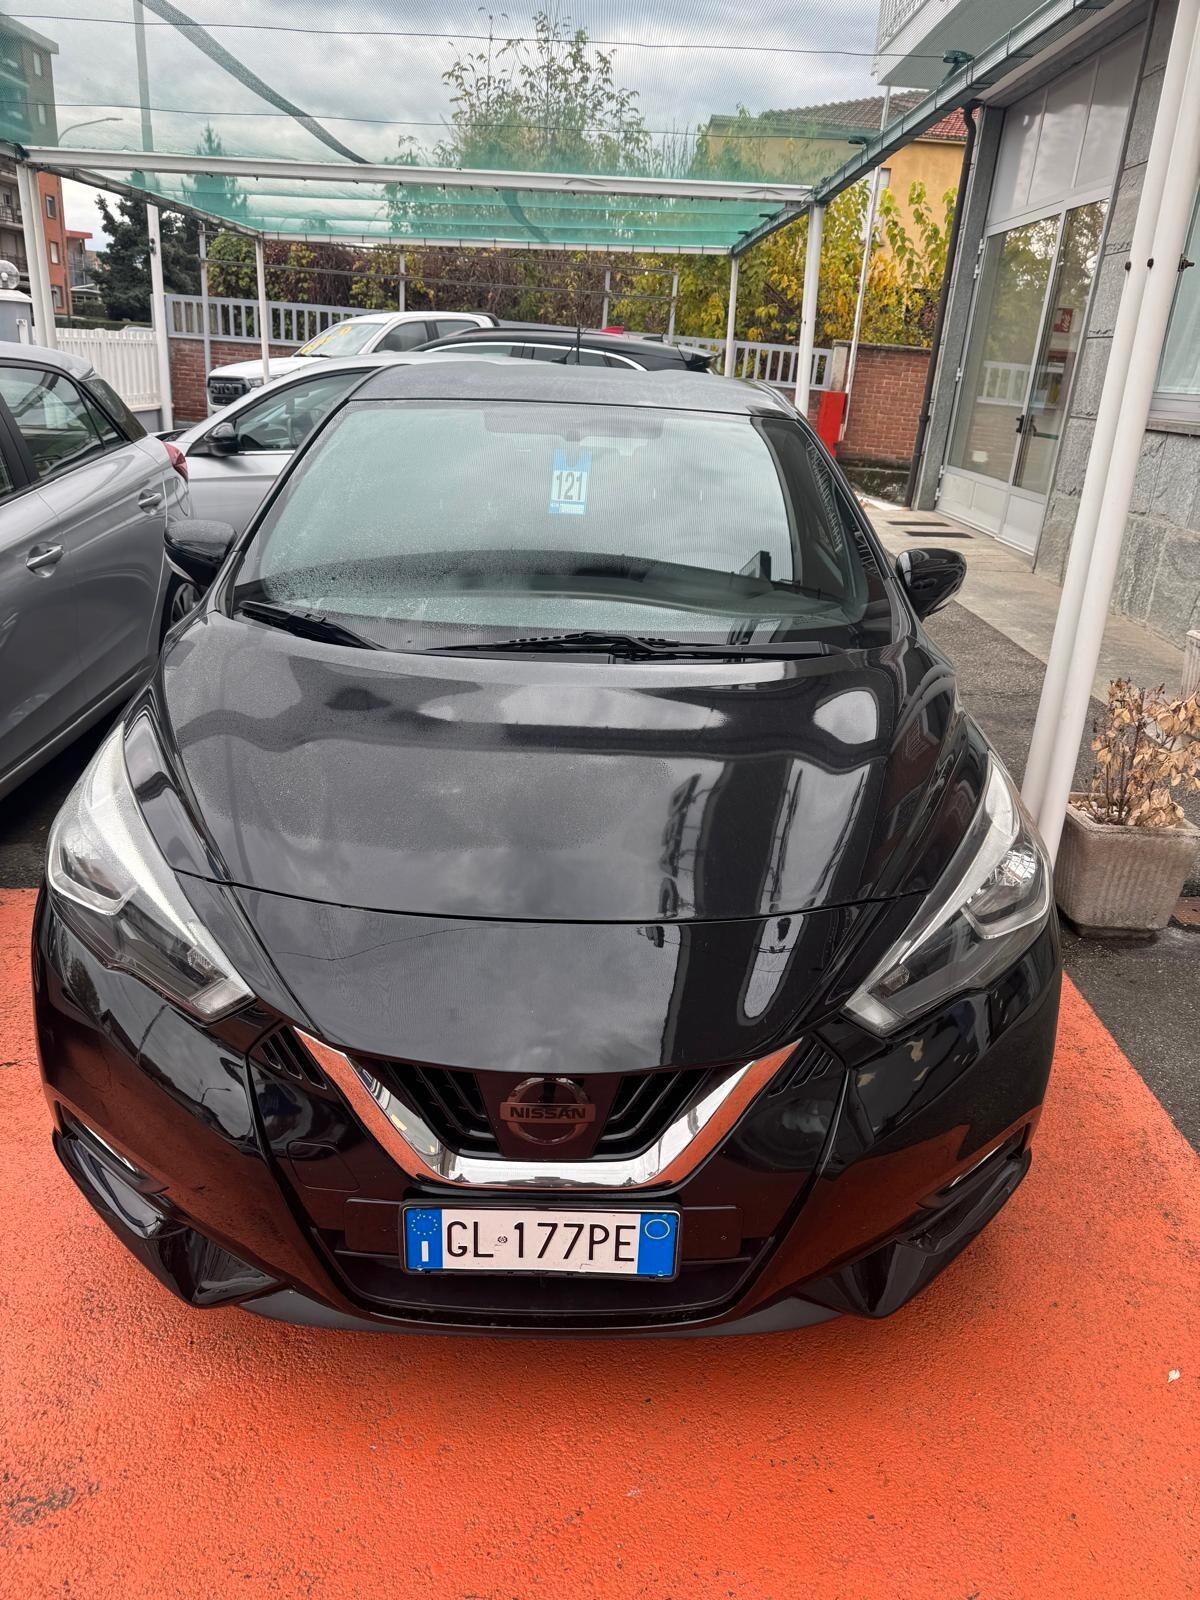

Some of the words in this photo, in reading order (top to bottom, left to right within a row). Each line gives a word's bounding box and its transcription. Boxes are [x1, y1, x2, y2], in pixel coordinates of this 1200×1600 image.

[556, 471, 583, 501] 121
[510, 1107, 586, 1119] NISSAN
[446, 1221, 494, 1258] GL
[514, 1222, 636, 1262] 177PE
